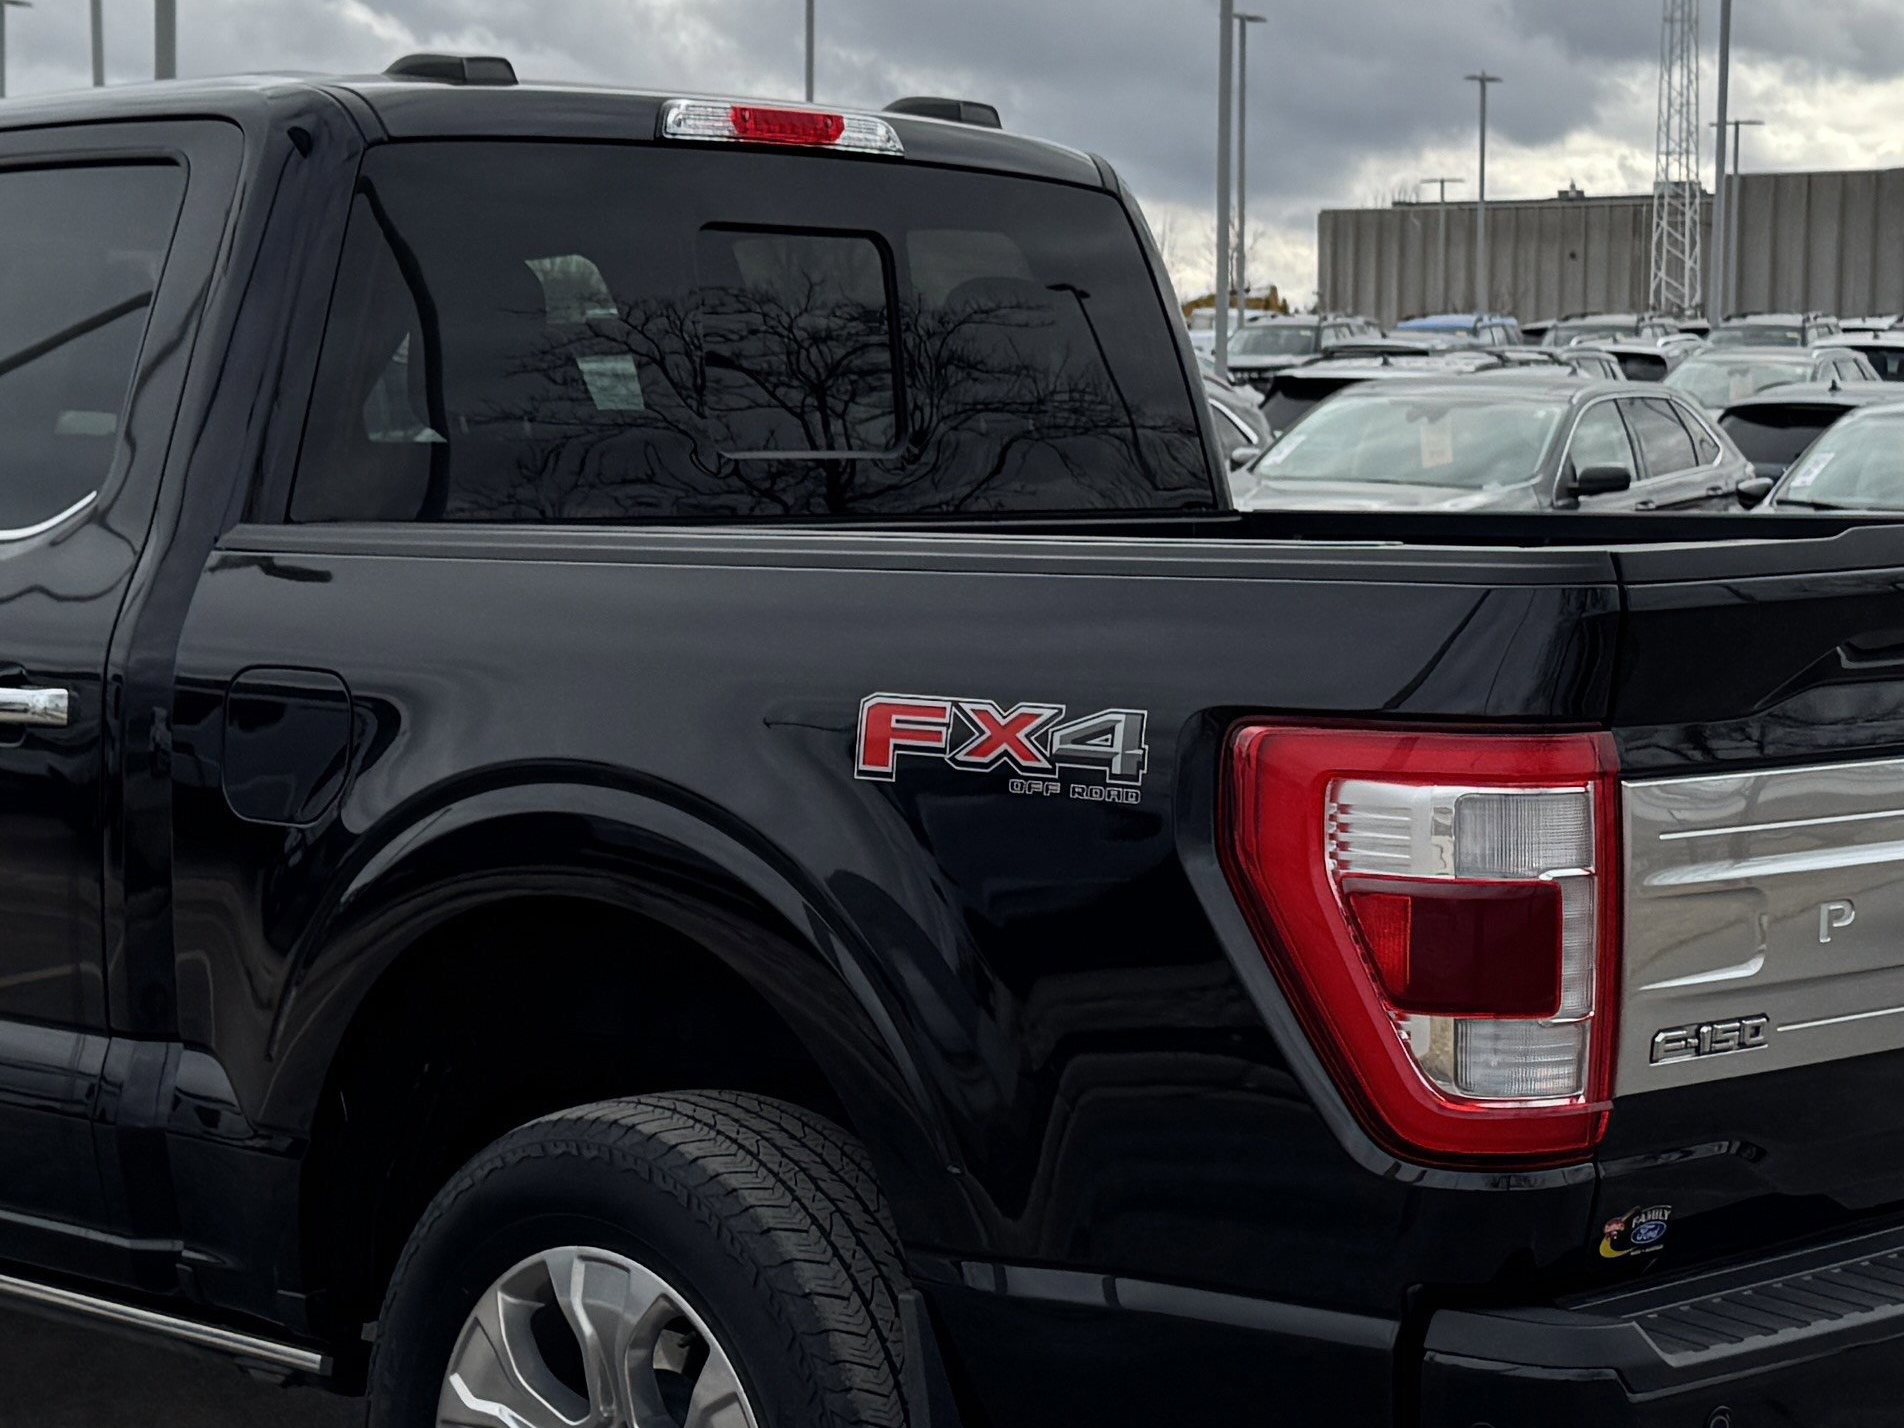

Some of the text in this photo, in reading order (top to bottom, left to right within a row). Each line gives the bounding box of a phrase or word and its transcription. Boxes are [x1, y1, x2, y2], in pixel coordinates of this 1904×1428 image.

[854, 692, 1148, 785] FX4
[1008, 779, 1142, 804] OFF ROAD
[1650, 1013, 1770, 1066] F-150
